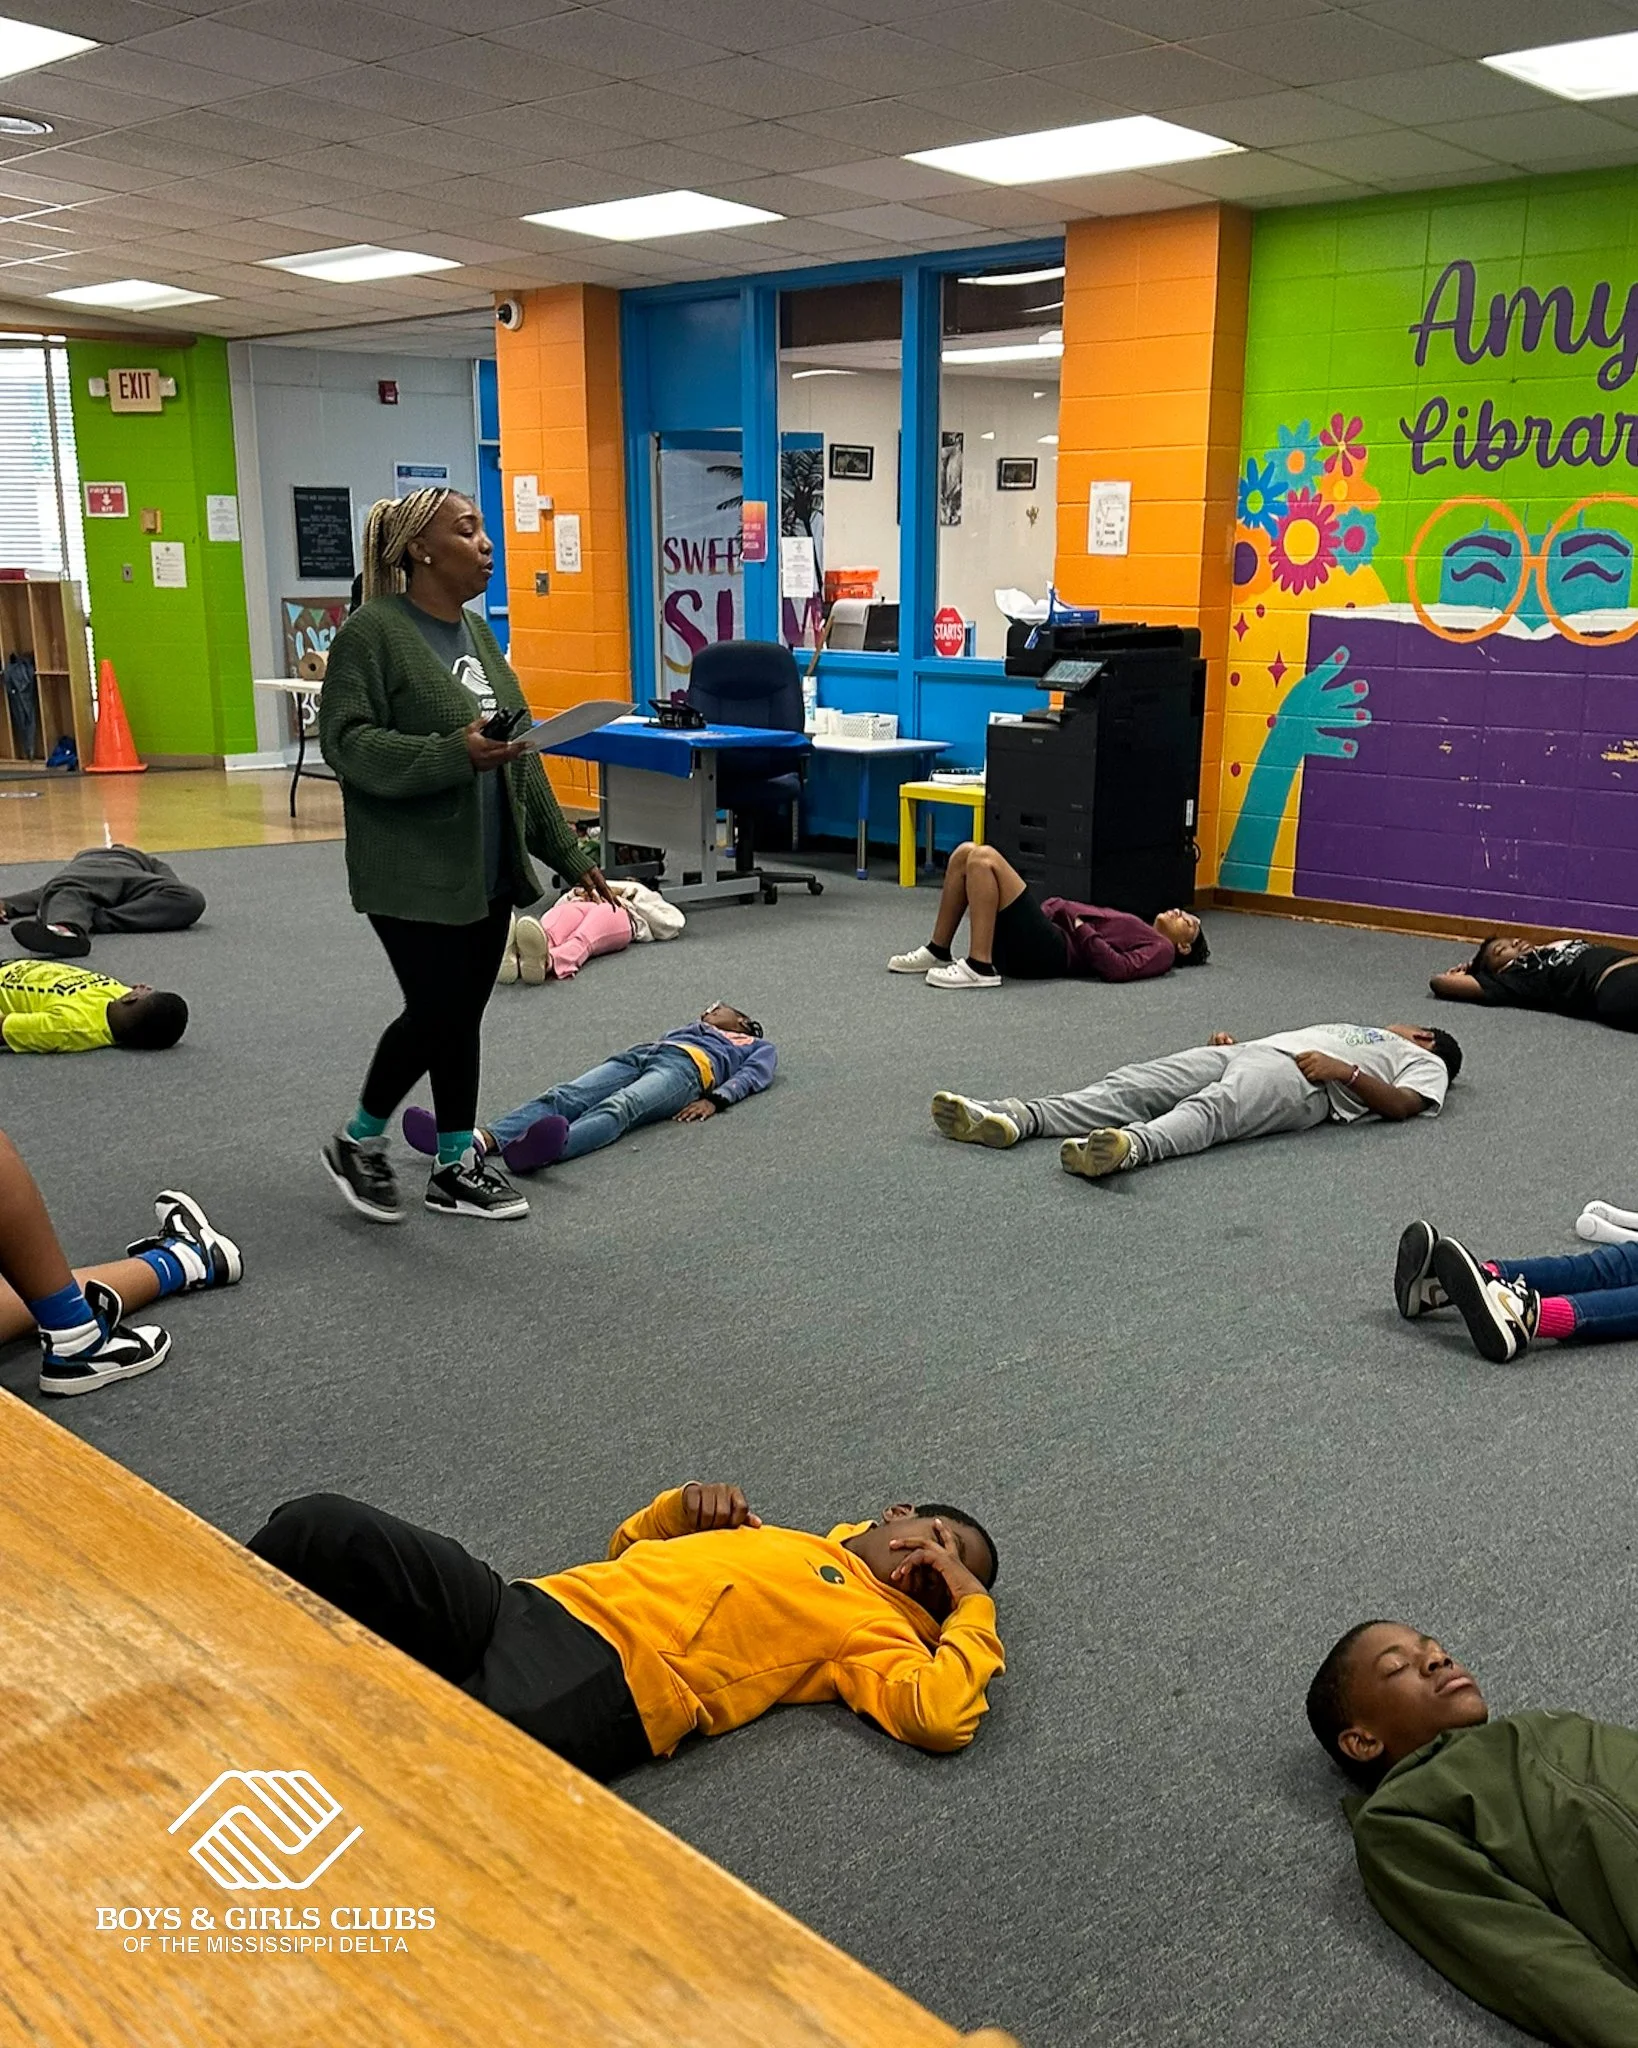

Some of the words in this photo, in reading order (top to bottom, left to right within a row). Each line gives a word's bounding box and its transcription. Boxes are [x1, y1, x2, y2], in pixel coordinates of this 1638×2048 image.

[1408, 259, 1638, 391] Amy
[118, 372, 151, 399] EXIT
[934, 622, 963, 641] STARTS
